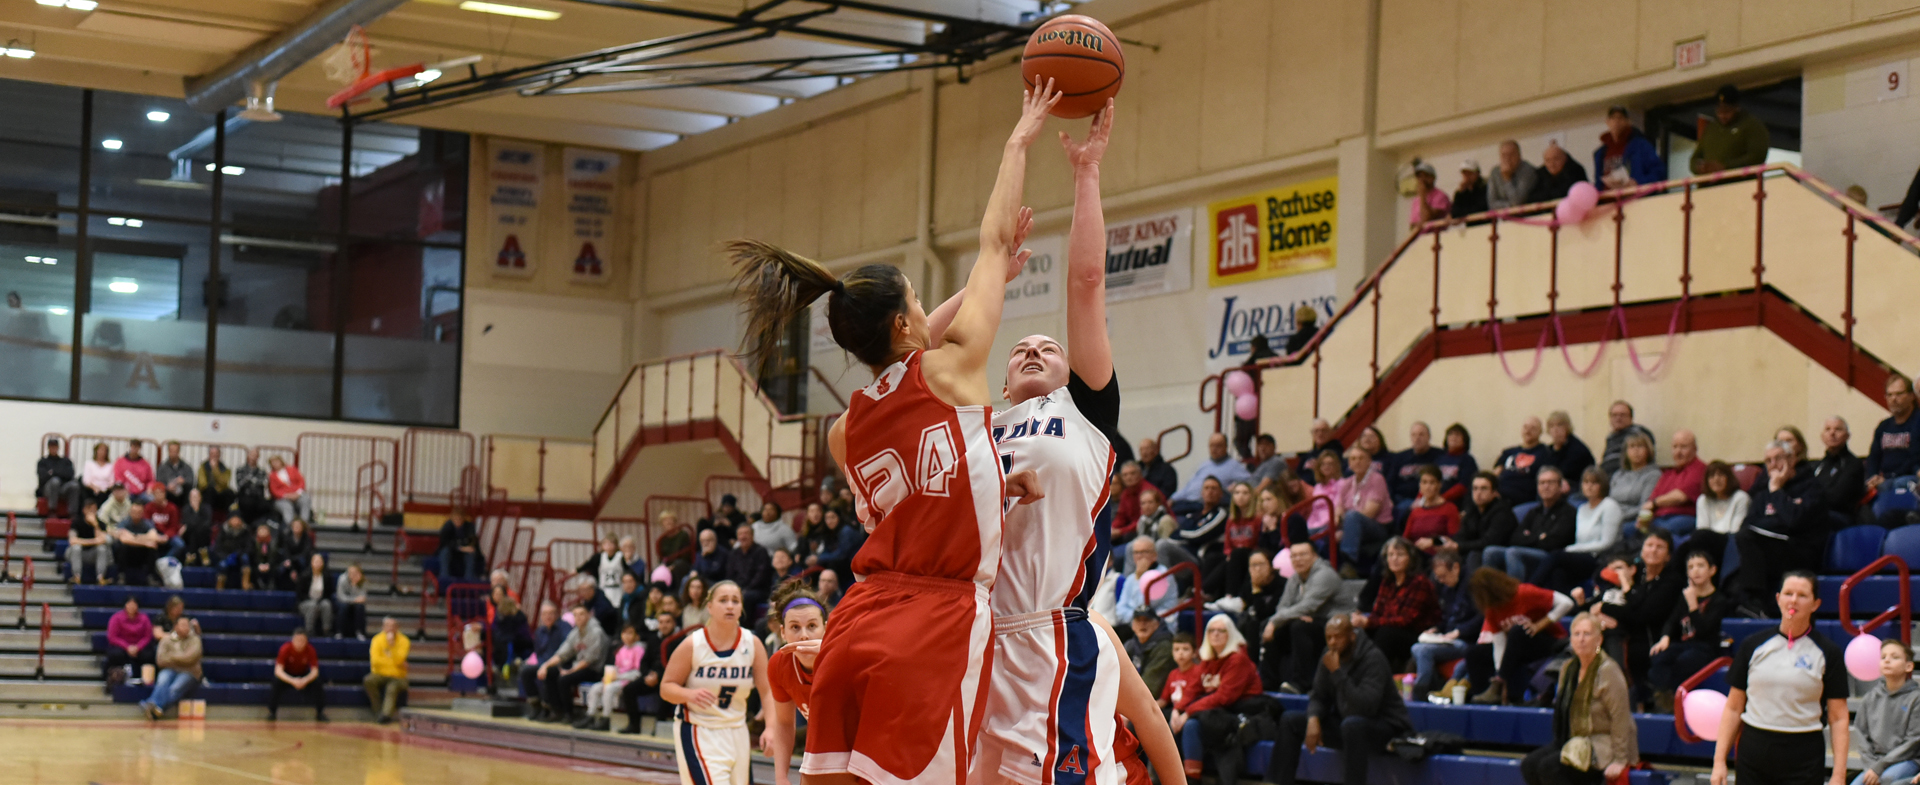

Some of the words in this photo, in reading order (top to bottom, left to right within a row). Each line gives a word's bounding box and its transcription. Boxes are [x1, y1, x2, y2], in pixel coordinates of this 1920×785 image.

[1037, 29, 1104, 53] Wilson
[1887, 71, 1900, 91] 9
[1107, 225, 1132, 247] THE
[1134, 215, 1180, 242] KINGS
[1269, 221, 1331, 252] Home
[1106, 236, 1174, 274] utual
[1209, 294, 1337, 359] JORDA'S
[854, 420, 959, 521] 24
[696, 666, 754, 679] ACADIA
[718, 685, 737, 709] 5
